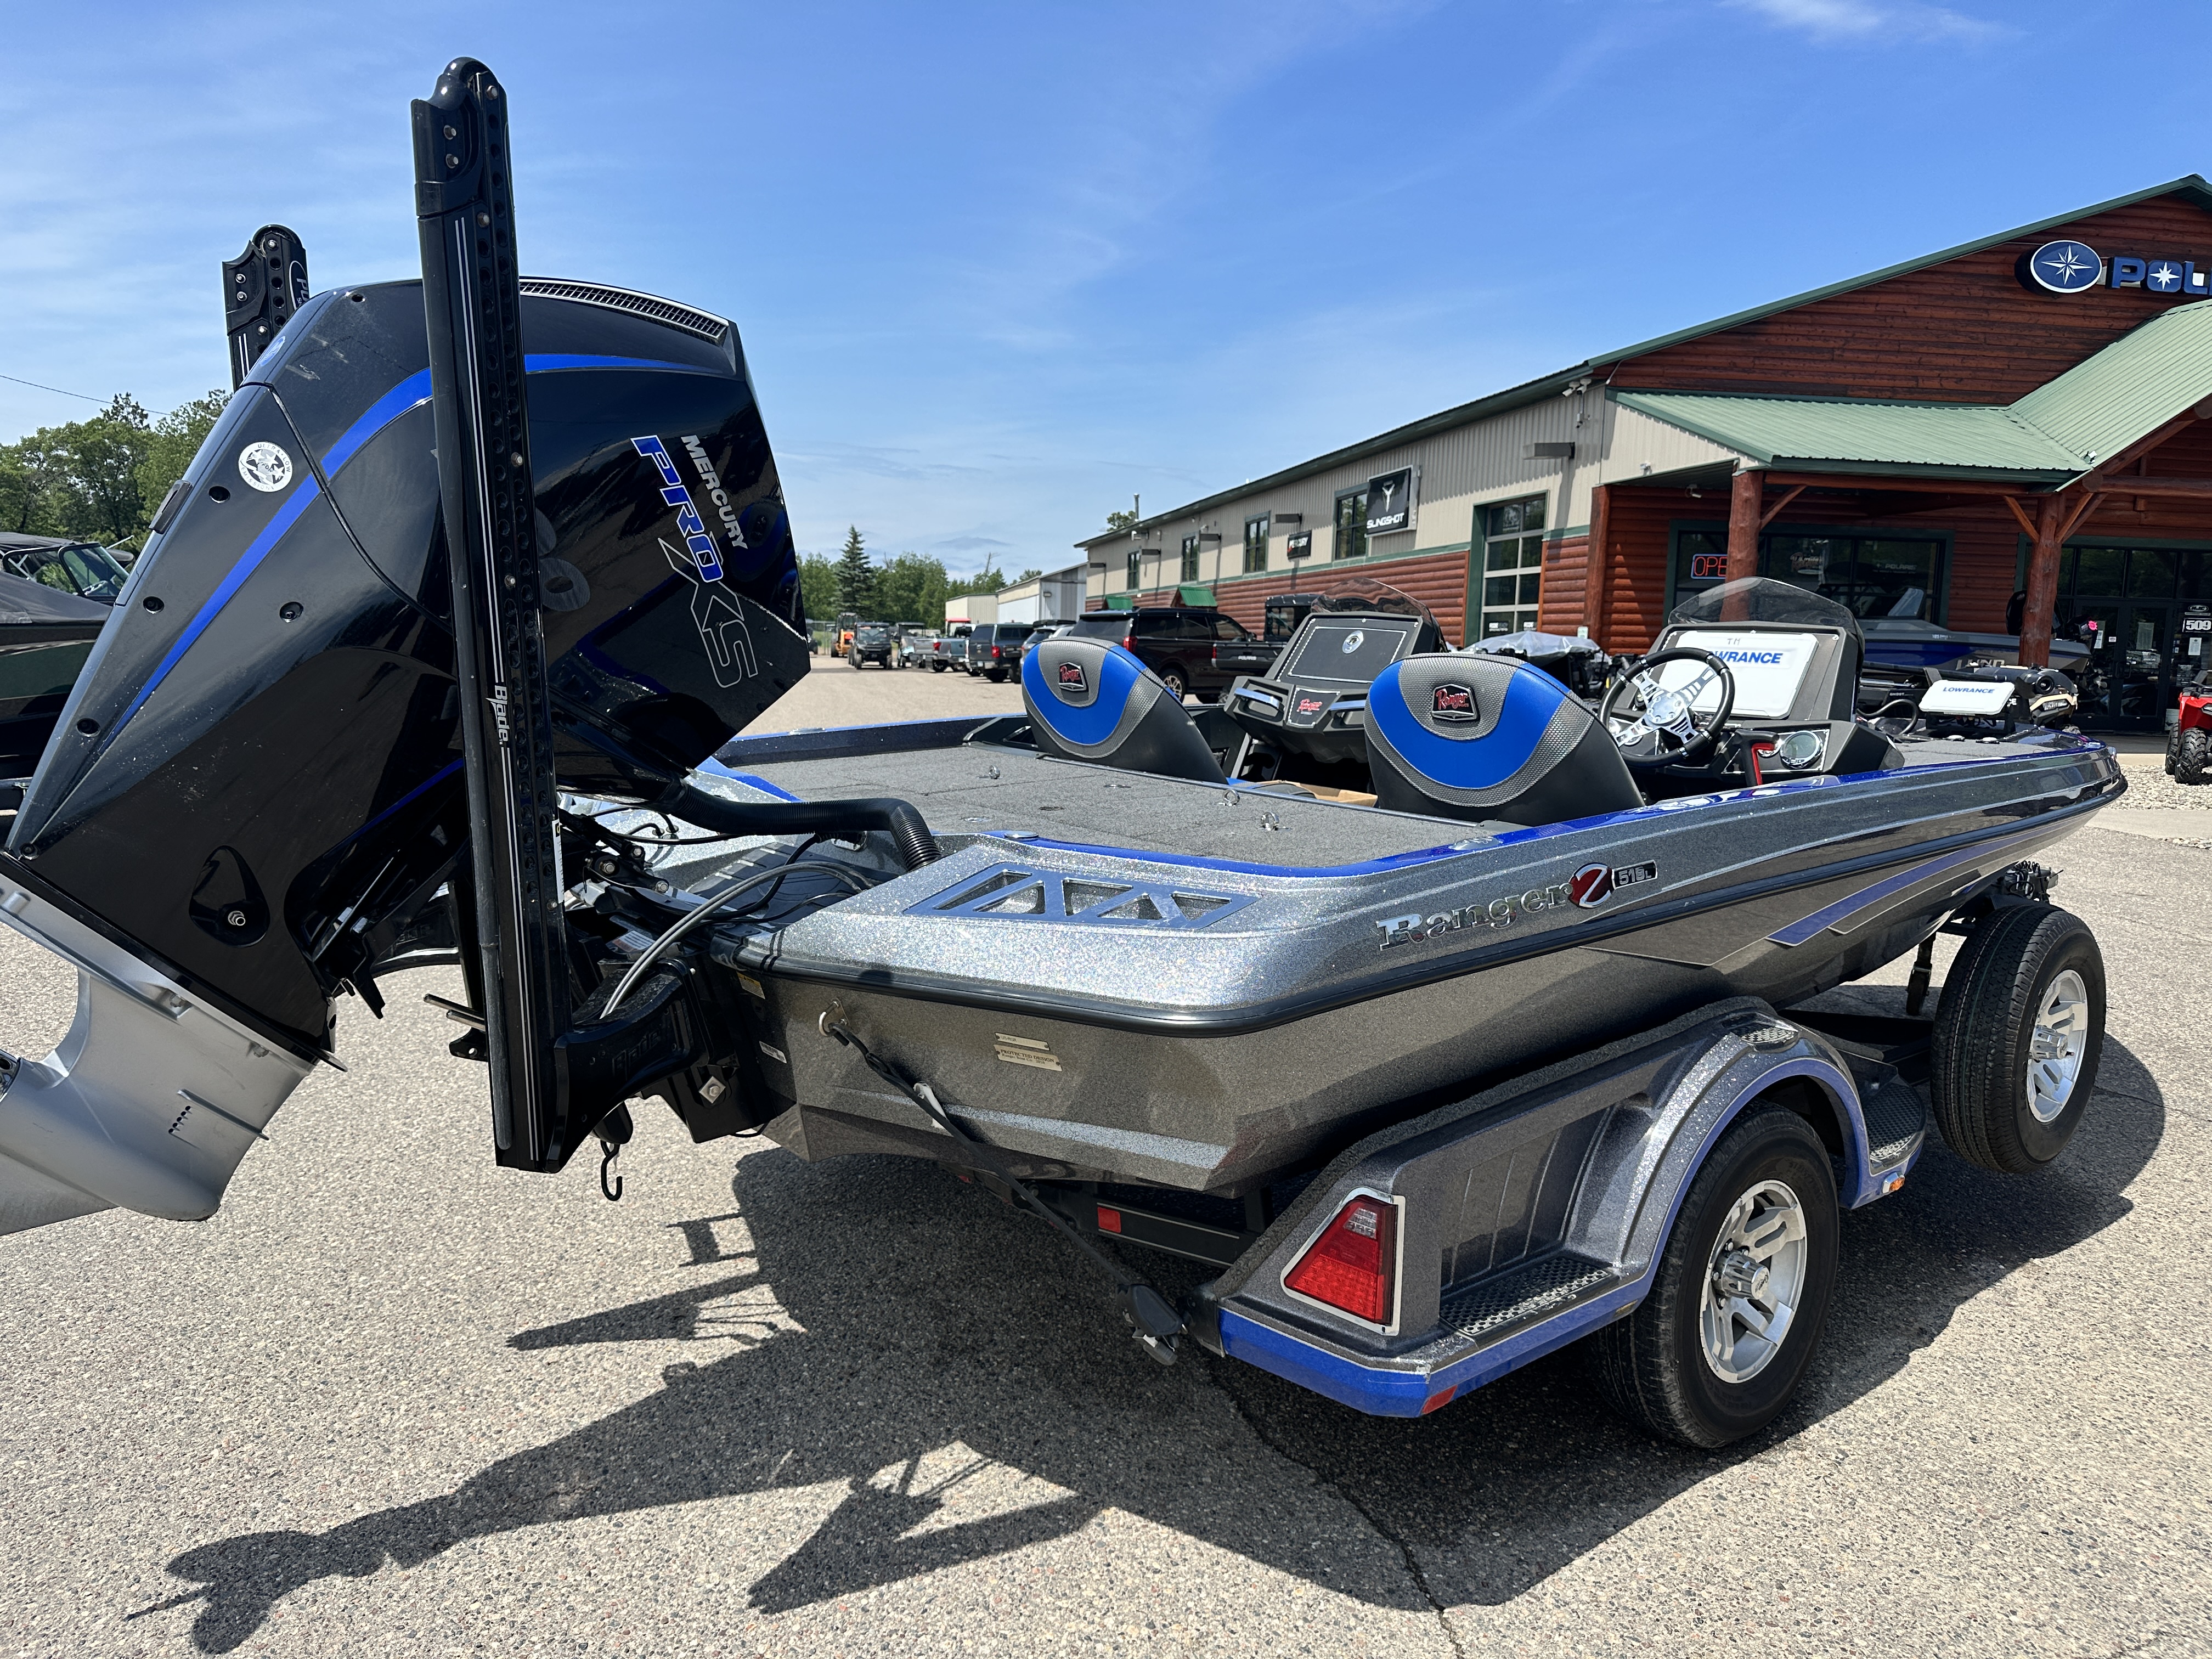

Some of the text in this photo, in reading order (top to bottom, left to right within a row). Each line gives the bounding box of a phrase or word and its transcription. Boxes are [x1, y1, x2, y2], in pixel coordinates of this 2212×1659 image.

[2112, 256, 2212, 296] POL
[681, 435, 748, 549] MERCURY
[630, 435, 724, 583] PRO
[1366, 512, 1404, 529] SLINGSHOT
[1694, 556, 1727, 577] OPE
[2186, 620, 2211, 630] 509
[1712, 651, 1783, 664] WRANCE
[1435, 688, 1469, 710] Ranger
[486, 685, 510, 742] Blade
[1375, 882, 1573, 952] Ranger
[1000, 1049, 1054, 1063] PROTECTED DESIGN
